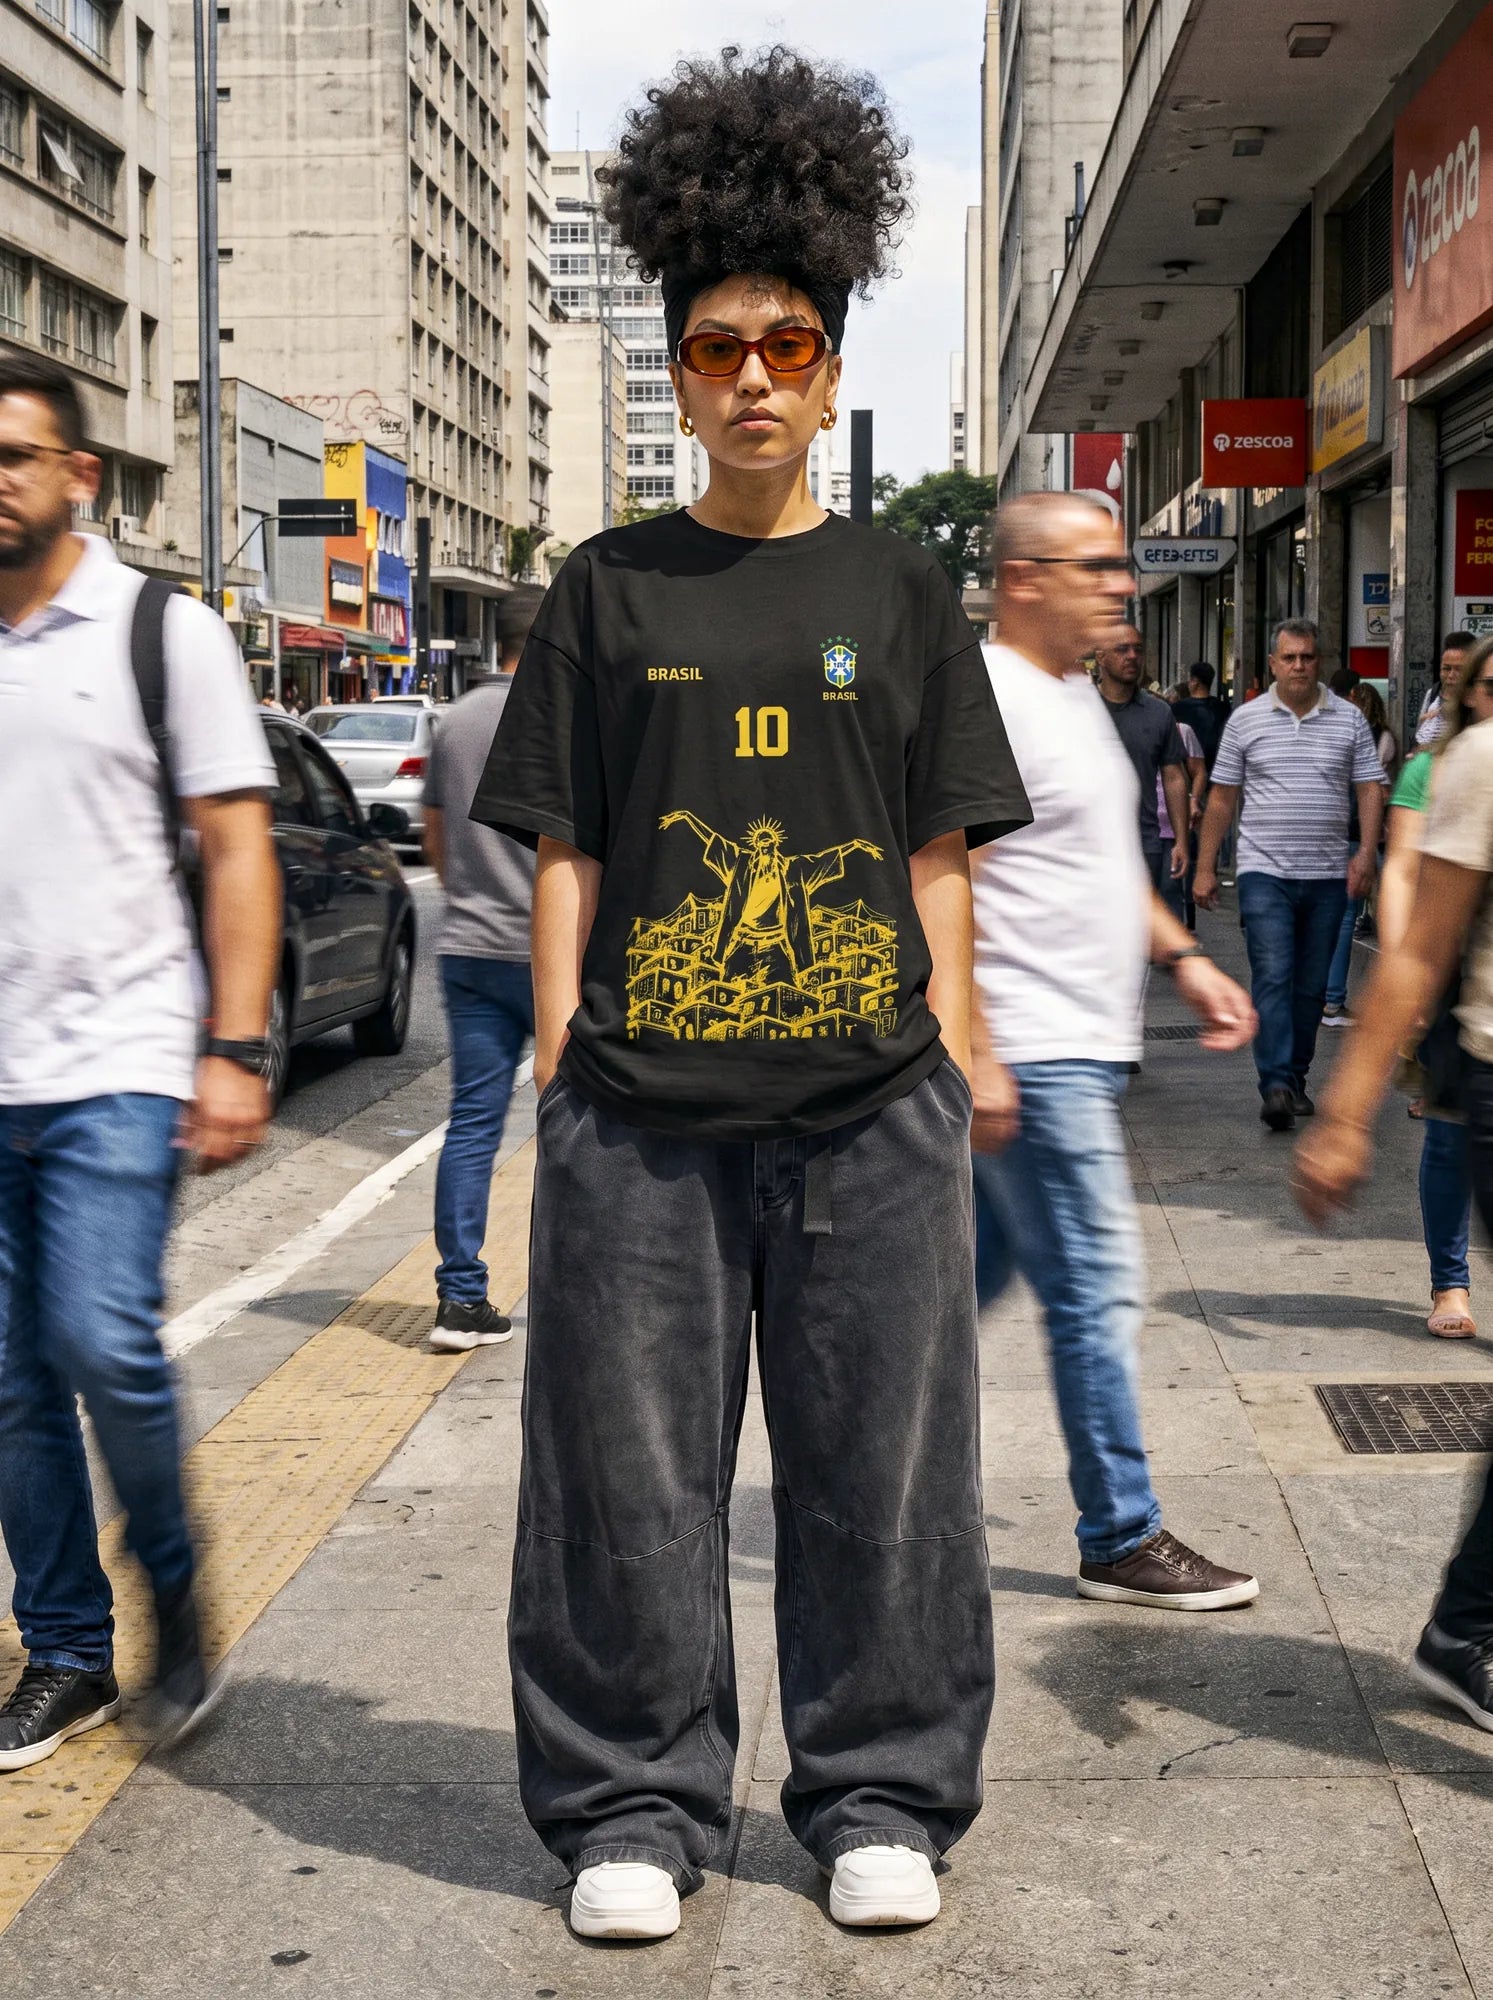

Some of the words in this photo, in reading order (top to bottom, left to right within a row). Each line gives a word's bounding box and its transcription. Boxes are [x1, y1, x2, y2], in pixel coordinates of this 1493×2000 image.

[1420, 125, 1480, 264] zecoa
[1234, 435, 1293, 449] zescoa
[647, 667, 703, 682] BRASIL
[822, 691, 859, 701] BRASIL
[735, 706, 788, 757] 10
